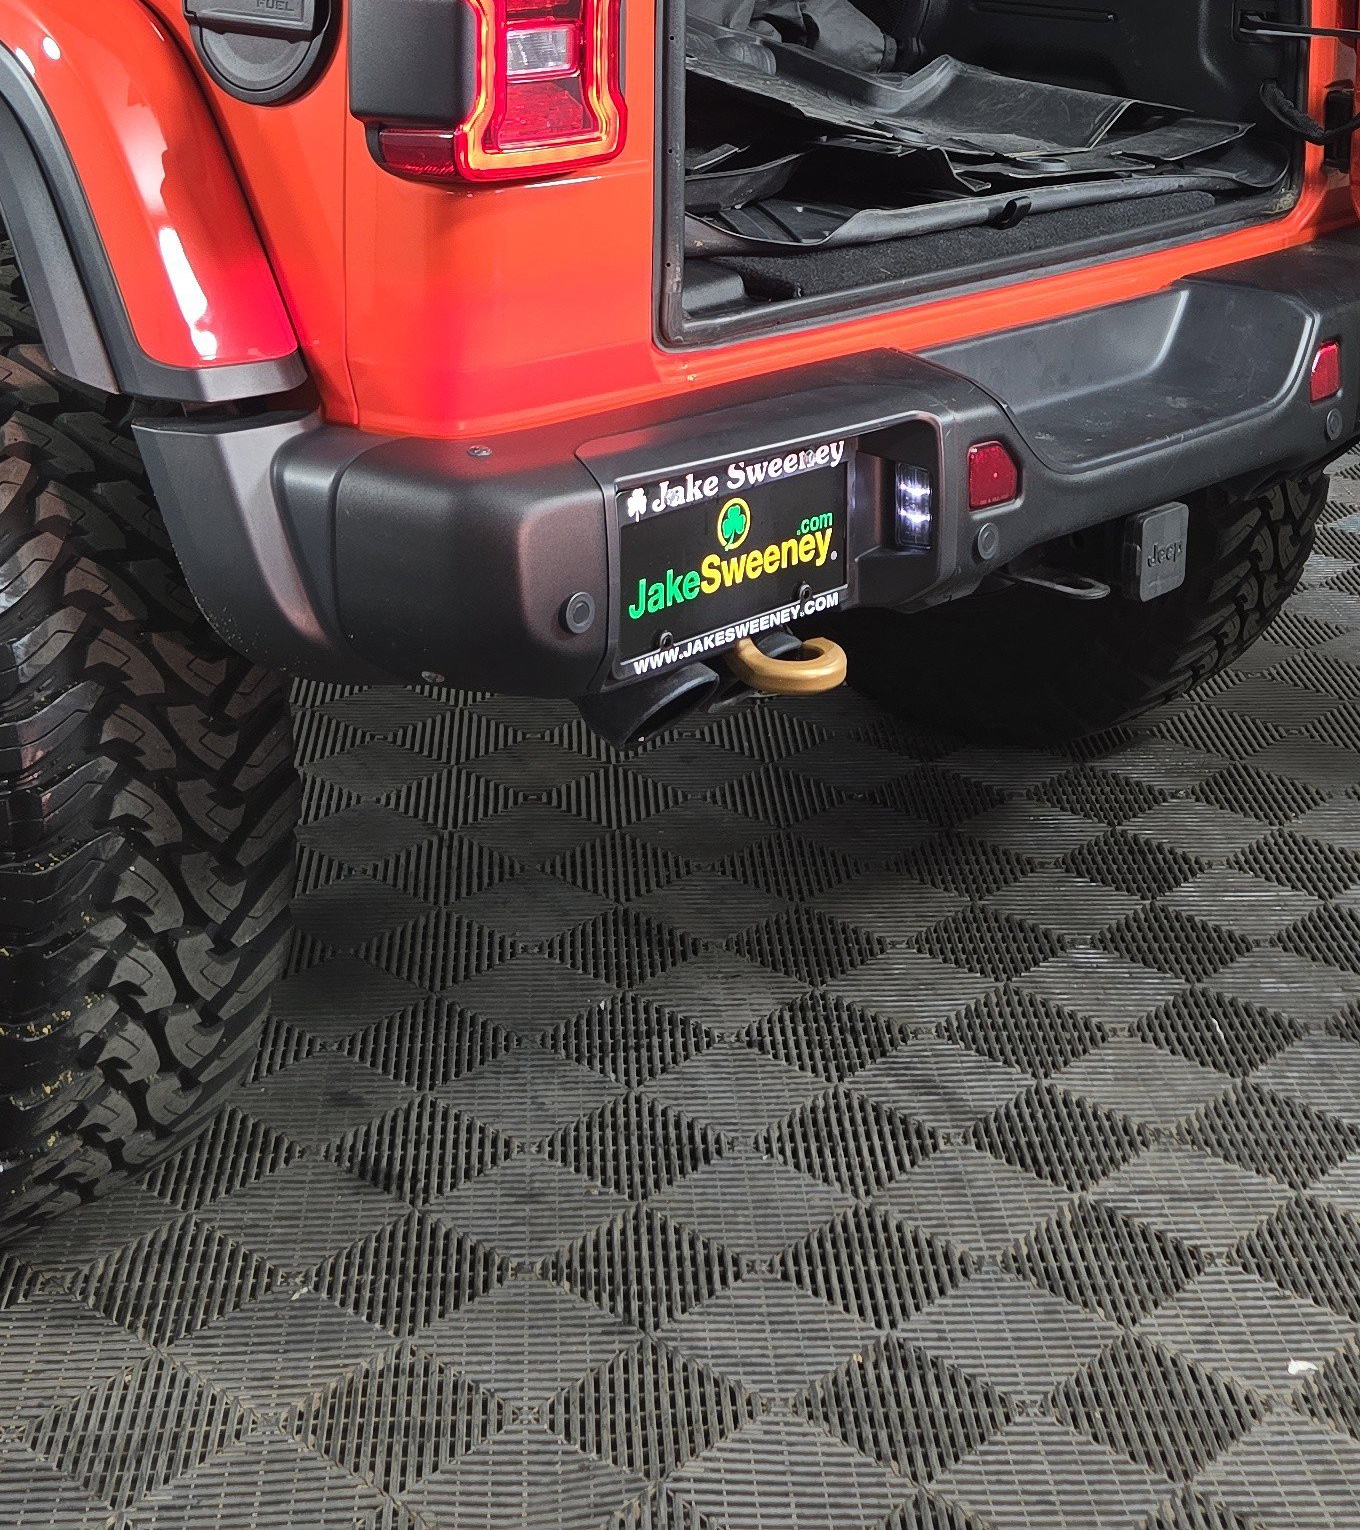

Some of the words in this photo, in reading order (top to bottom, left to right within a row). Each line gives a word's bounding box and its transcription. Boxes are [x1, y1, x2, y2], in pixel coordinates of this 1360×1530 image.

[651, 469, 720, 513] Jake
[726, 441, 845, 492] Sweeney
[796, 511, 833, 536] .com
[633, 592, 839, 674] WWW.JAKESWEENEY.COM
